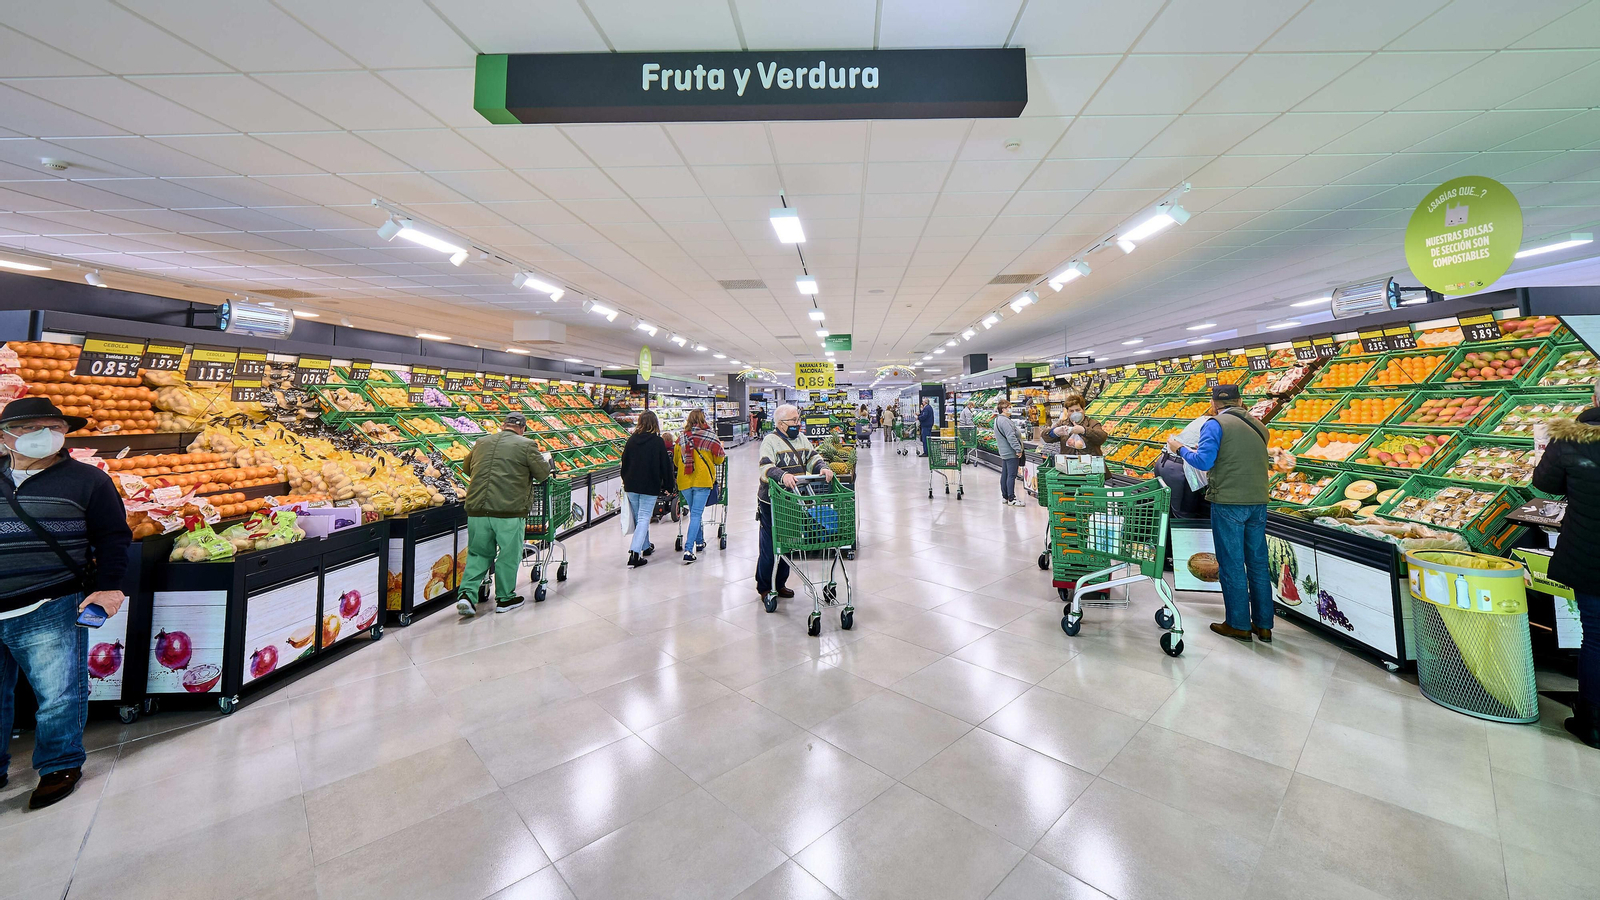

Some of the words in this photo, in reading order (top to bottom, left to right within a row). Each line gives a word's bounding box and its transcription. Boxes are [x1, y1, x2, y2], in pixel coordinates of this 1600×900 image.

[641, 62, 725, 91] Fruta
[733, 67, 751, 96] y
[756, 61, 880, 90] Verdura
[1427, 188, 1458, 213] ¿SABÍAS
[1426, 230, 1462, 247] NUESTRAS
[1463, 222, 1494, 239] BOLSAS
[1430, 247, 1441, 258] DE
[1441, 239, 1472, 255] SECCIÓN
[1473, 235, 1490, 249] SON
[1433, 248, 1490, 268] COMPOSTABLES
[797, 376, 825, 389] 0,89
